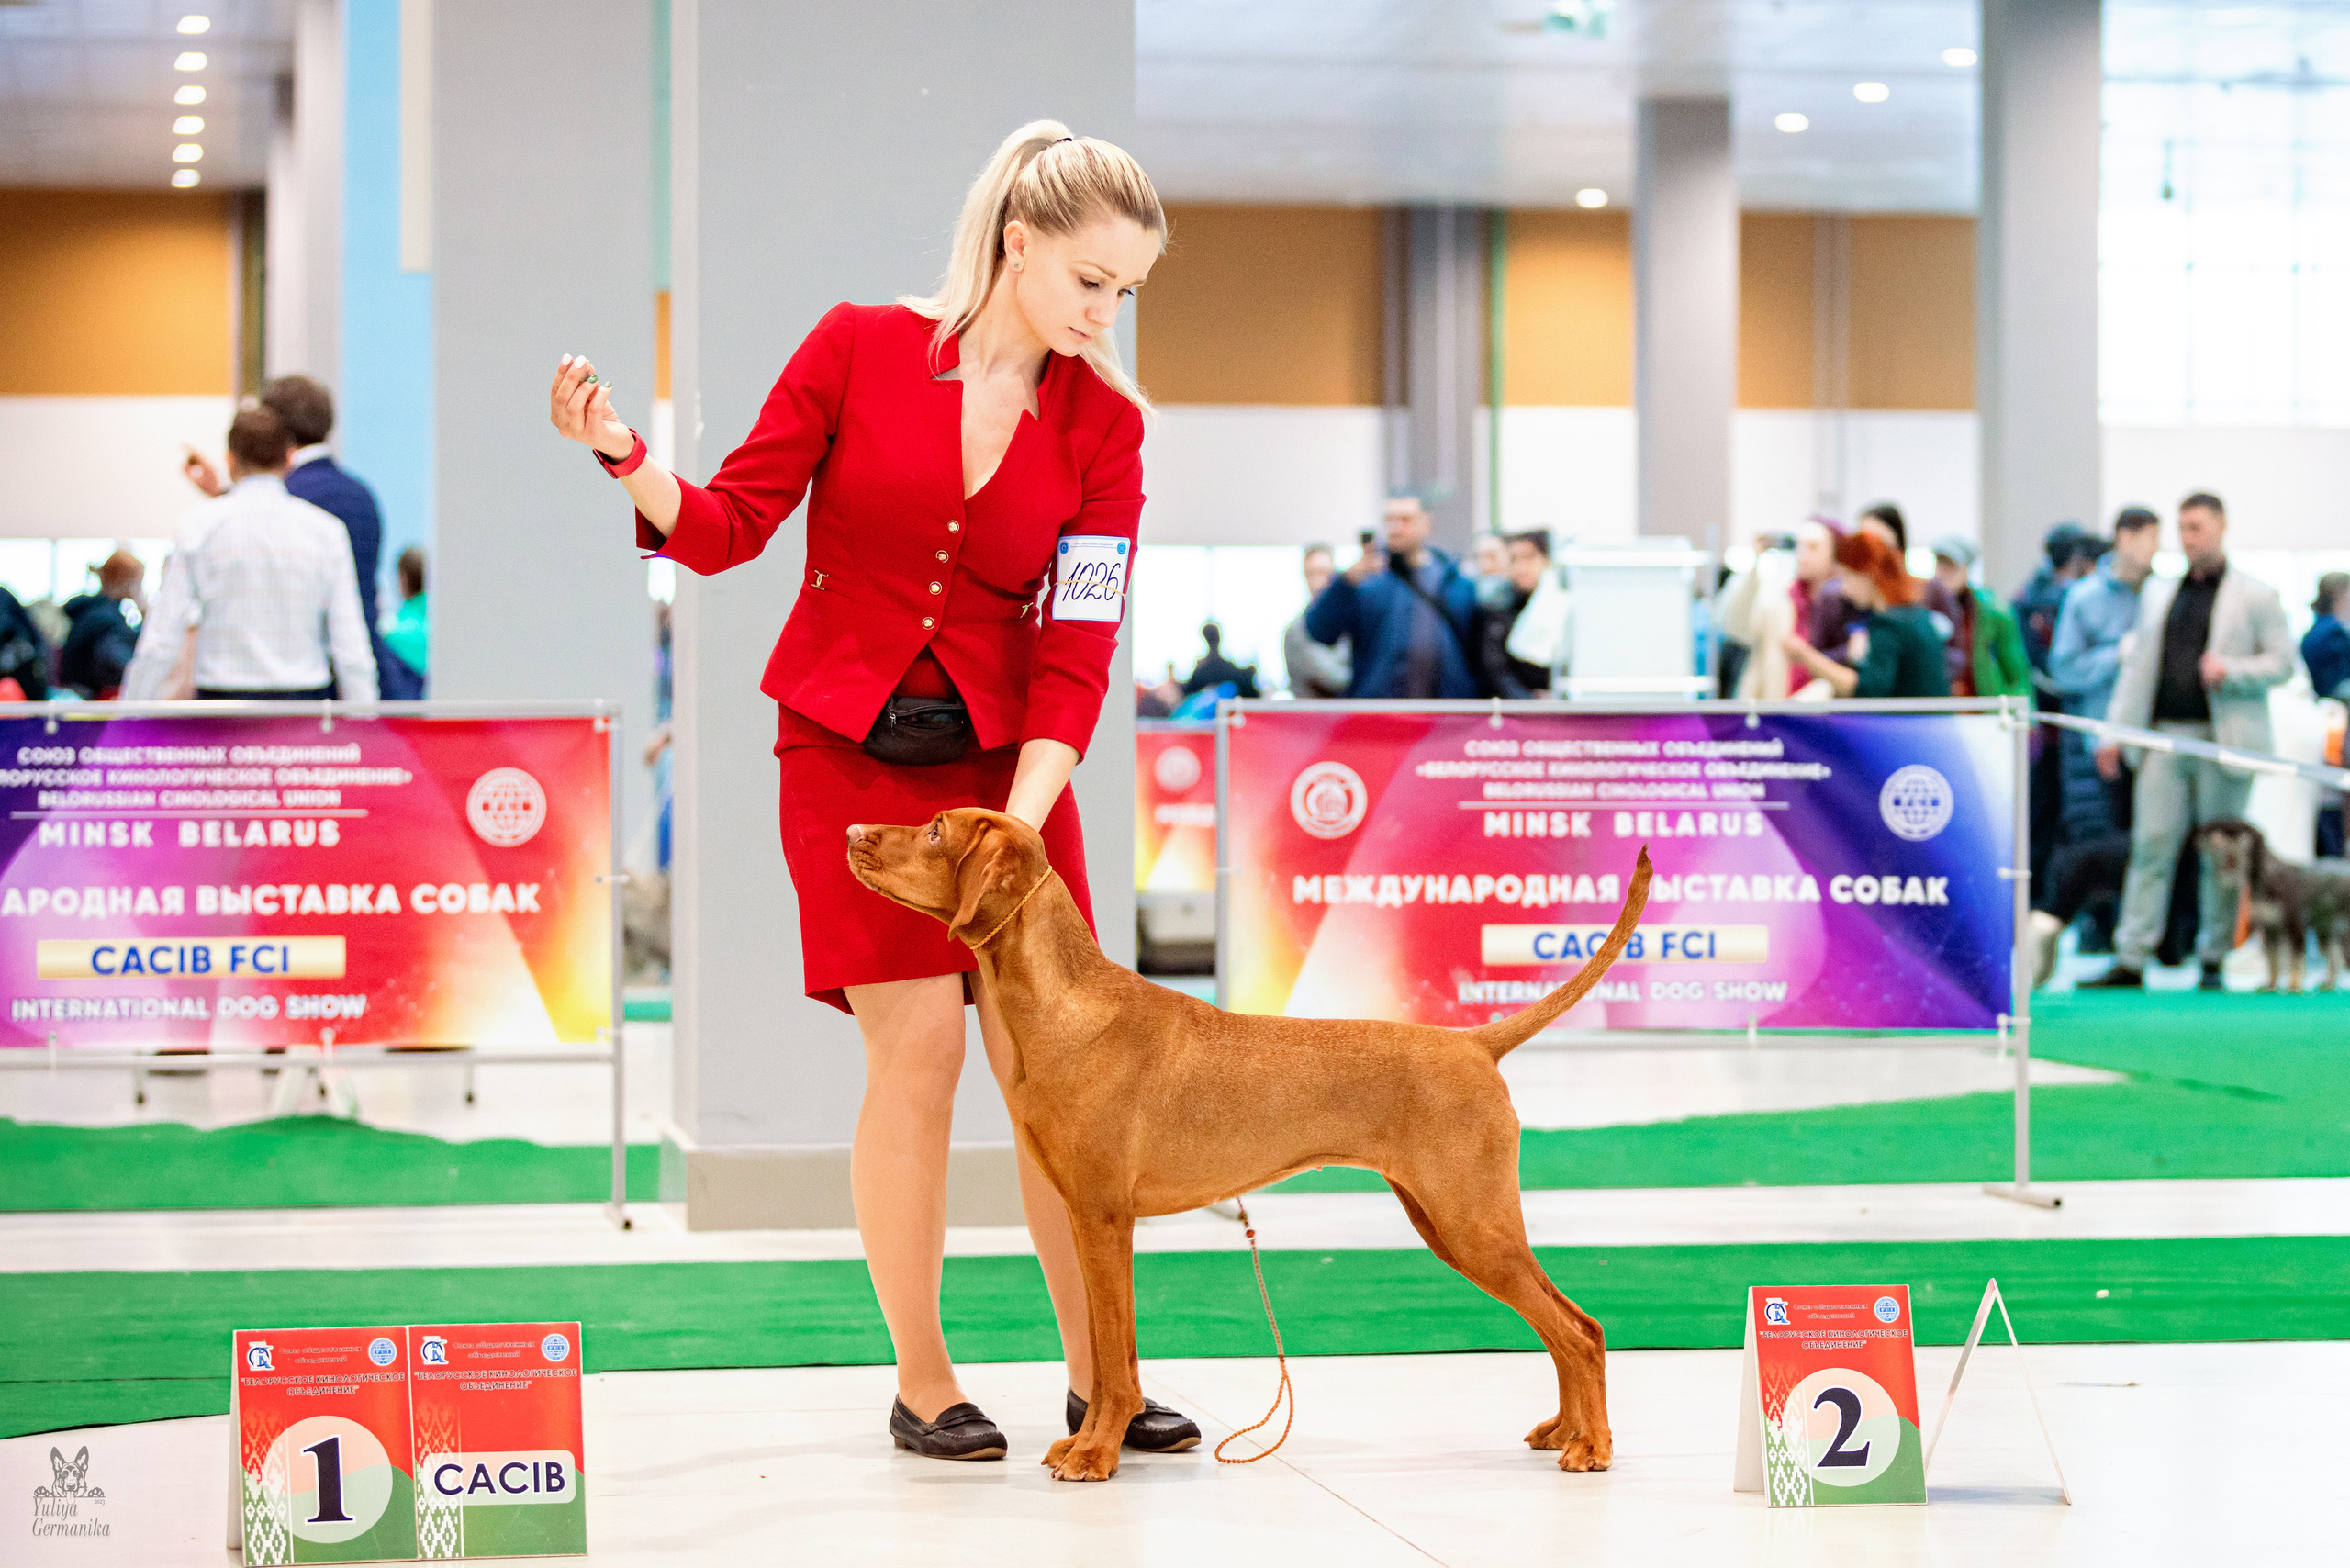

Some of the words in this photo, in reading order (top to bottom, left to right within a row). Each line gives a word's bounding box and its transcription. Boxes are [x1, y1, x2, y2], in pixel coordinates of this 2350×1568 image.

[1062, 561, 1121, 602] 1026
[283, 789, 341, 807] UNION
[39, 820, 154, 848] MINSK
[179, 818, 341, 848] BELARUS
[1483, 812, 1593, 838] MINSK
[1614, 811, 1764, 838] BELARUS
[195, 883, 402, 916] ВЫСТАВКА
[409, 882, 542, 914] СОБАК
[1292, 873, 1620, 908] МЕЖДУНАРОДНАЯ
[1649, 873, 1821, 903] ЫСТАВКА
[1829, 874, 1950, 906] СОБАК
[91, 945, 212, 976] CACIB
[229, 944, 290, 974] FCI
[1532, 931, 1646, 960] CACB
[1660, 931, 1717, 960] FCI
[1649, 980, 1705, 1002] DOG
[1714, 980, 1788, 1003] SHOW
[11, 995, 210, 1022] INTERNATIONAL
[217, 994, 280, 1020] DOG
[285, 993, 368, 1020] SHOW
[1759, 1330, 1826, 1339] "БЕЛОРУССКОЕ
[1828, 1328, 1908, 1338] КИНОЛОГИЧЕСКОЕ
[1801, 1340, 1868, 1350] ОБЪЕДИНЕНИЕ"
[241, 1375, 314, 1386] "БЕЛОРУССКОЕ
[316, 1372, 405, 1383] КИНОЛОГИЧЕСКОЕ
[413, 1370, 487, 1381] "БЕЛОРУССКОЕ
[489, 1368, 578, 1379] КИНОЛОГИЧЕСКОЕ
[460, 1380, 532, 1391] ОБЪЕДИНЕНИЕ"
[286, 1385, 360, 1396] ОБЪЕДИНЕНИЕ"
[1812, 1386, 1872, 1469] 2
[302, 1435, 355, 1525] 1
[432, 1460, 567, 1497] CACIB
